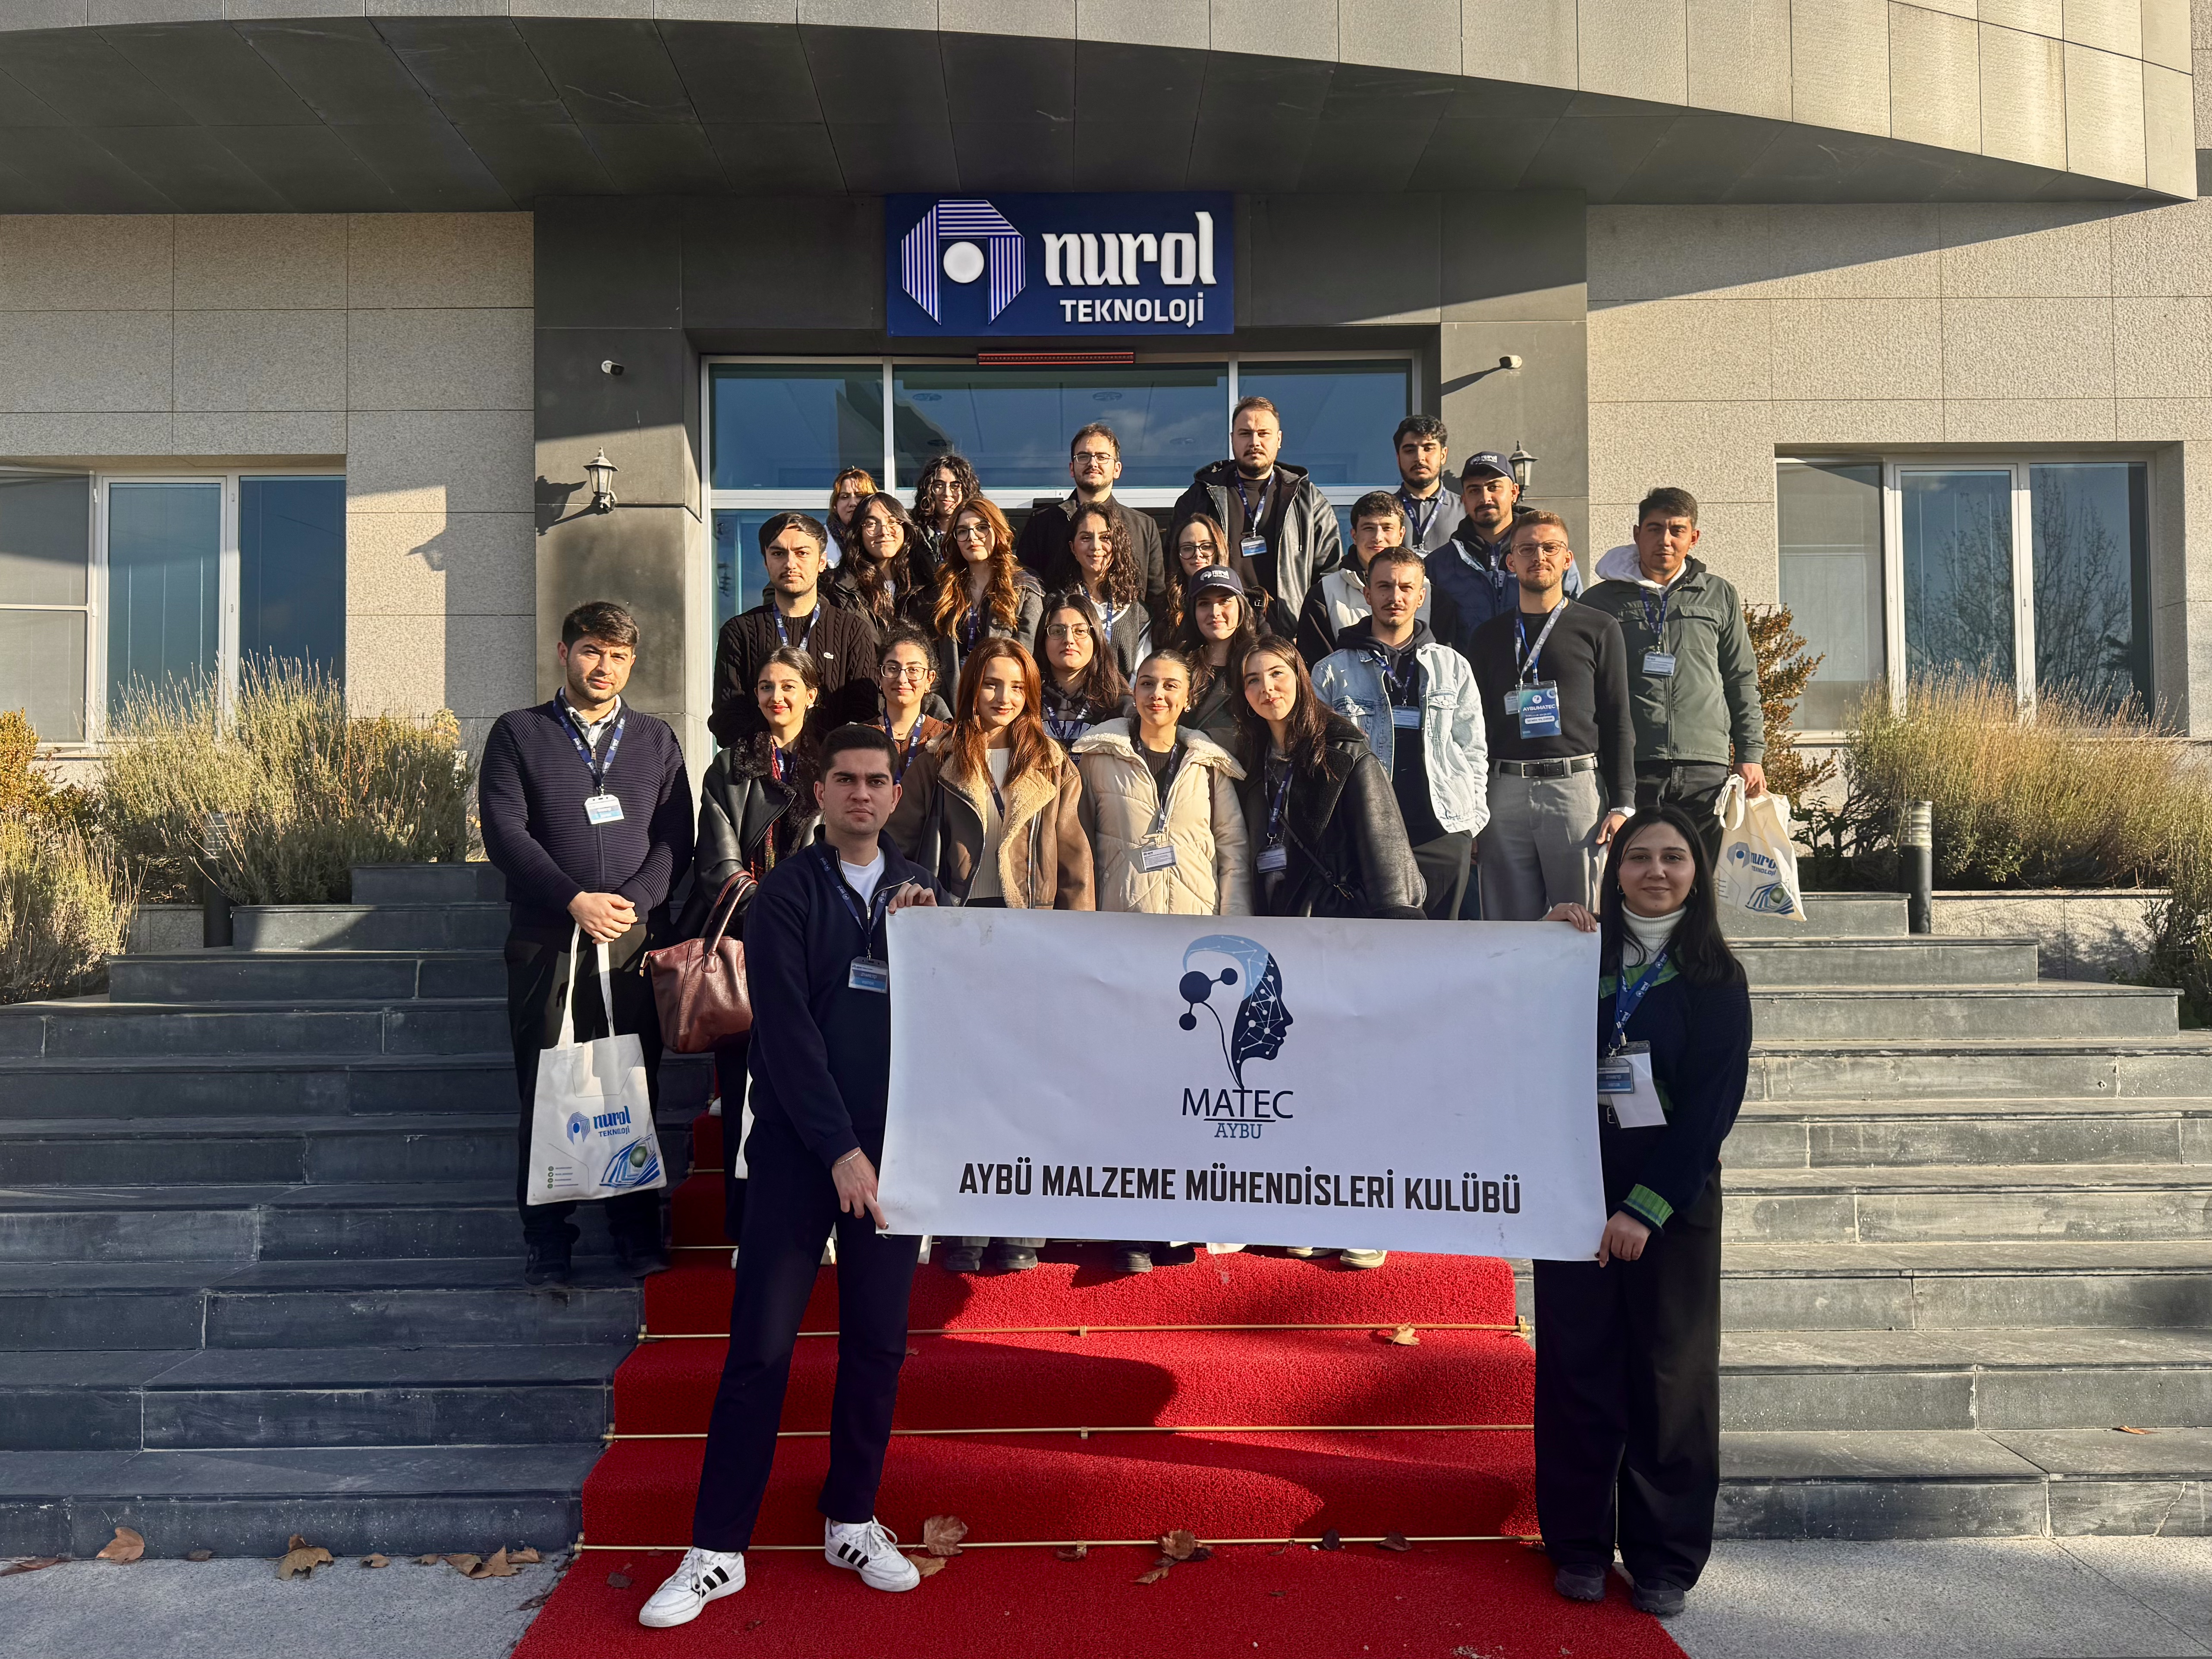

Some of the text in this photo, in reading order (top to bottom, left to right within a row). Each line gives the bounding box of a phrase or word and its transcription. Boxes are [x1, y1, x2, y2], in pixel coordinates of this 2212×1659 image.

[1042, 211, 1217, 286] nurol
[1751, 852, 1777, 869] nuro
[1182, 1088, 1294, 1119] MATEC
[593, 1106, 631, 1129] nurol
[1214, 1123, 1263, 1139] AYBU
[959, 1156, 1520, 1214] AYBÜ MALZEME MÜHENDİSLERİ KULÜBÜ
